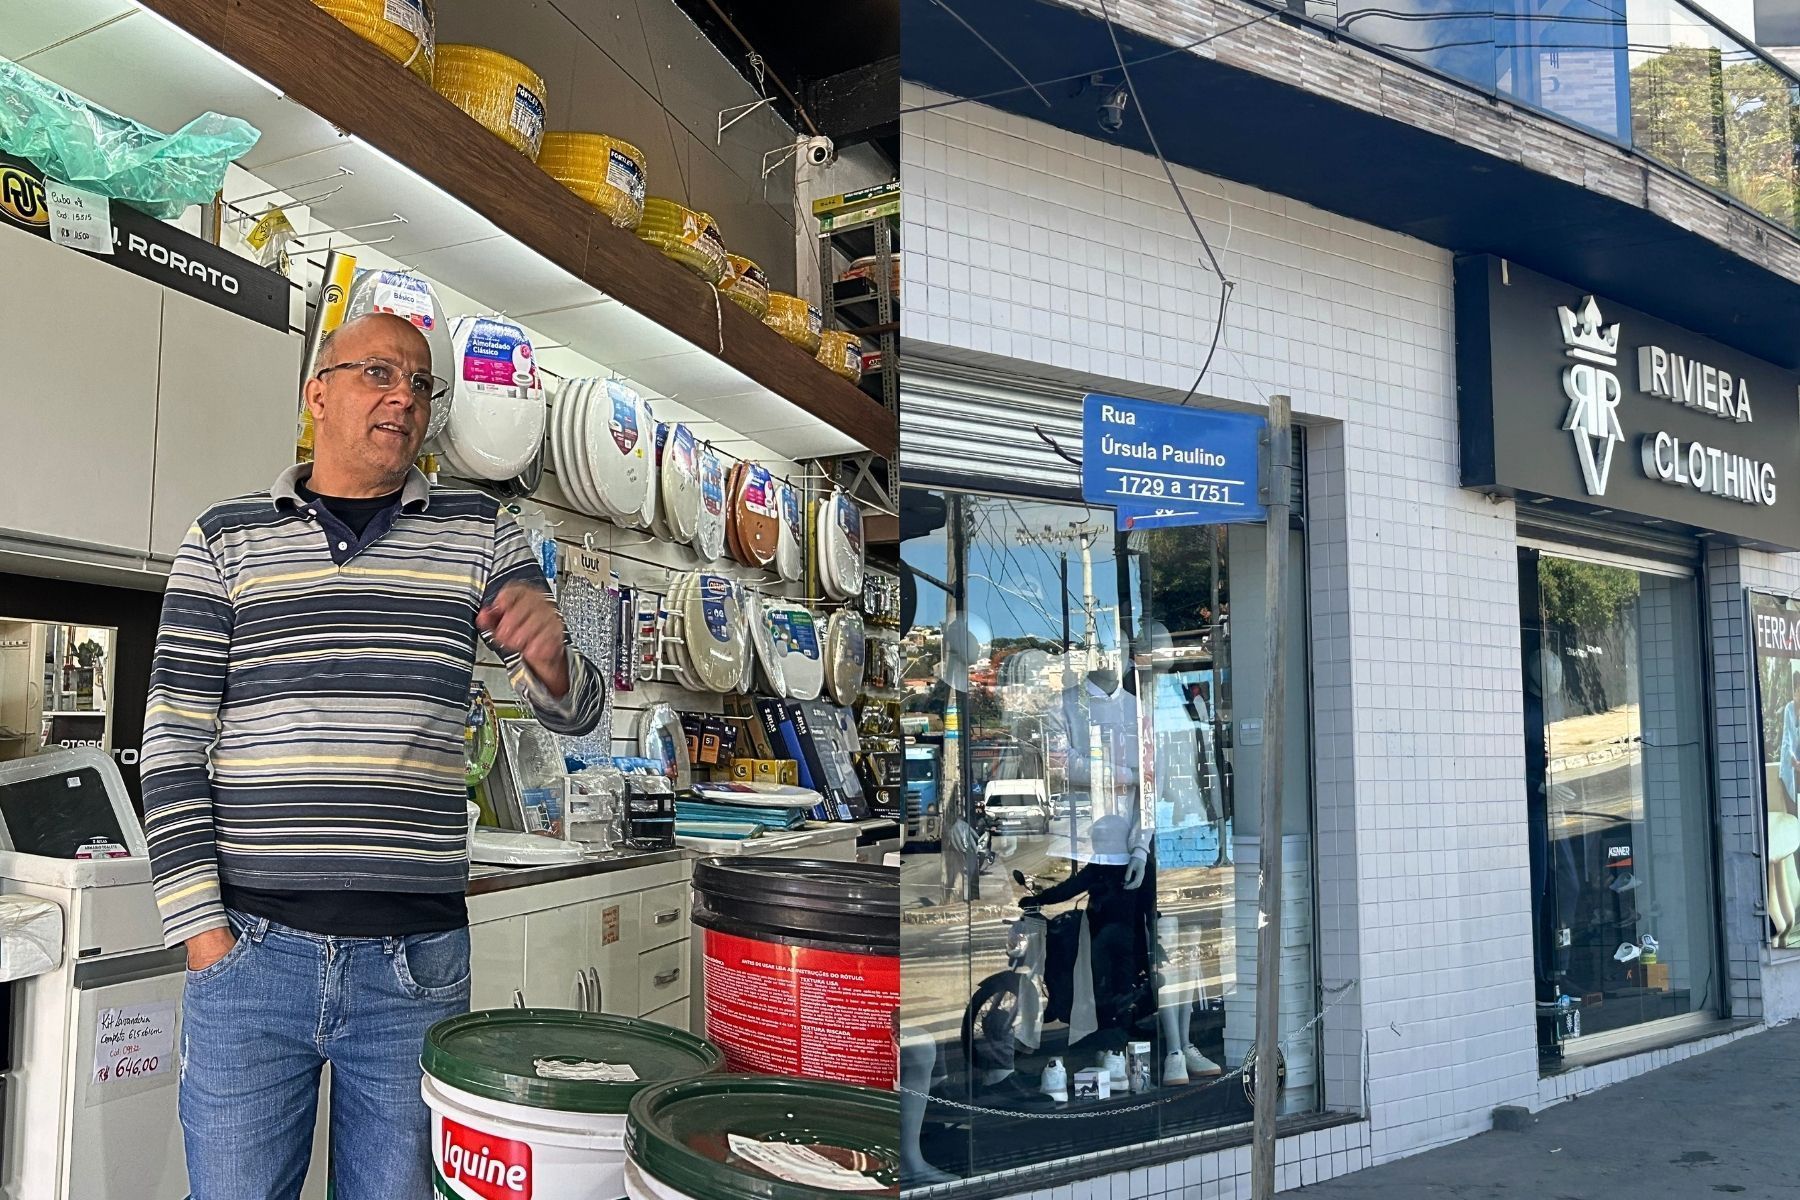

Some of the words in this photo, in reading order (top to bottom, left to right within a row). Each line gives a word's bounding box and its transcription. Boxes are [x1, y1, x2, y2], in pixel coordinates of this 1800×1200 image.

[129, 233, 239, 295] RORATO
[393, 292, 415, 303] Básico
[473, 339, 511, 351] Almofadado
[473, 346, 499, 356] Clássico
[1638, 346, 1753, 423] RIVIERA
[1101, 405, 1136, 426] Rua
[1101, 433, 1157, 460] Úrsula
[1162, 445, 1226, 467] Paulino
[1642, 431, 1776, 506] CLOTHING
[1119, 475, 1165, 496] 1729
[1170, 481, 1181, 494] a
[1188, 483, 1230, 503] 1751
[101, 1013, 114, 1030] Kit
[801, 1024, 826, 1033] TEXTURA
[826, 1028, 850, 1036] RISCADA
[116, 1056, 159, 1078] 646,00
[444, 1130, 527, 1192] Iquine
